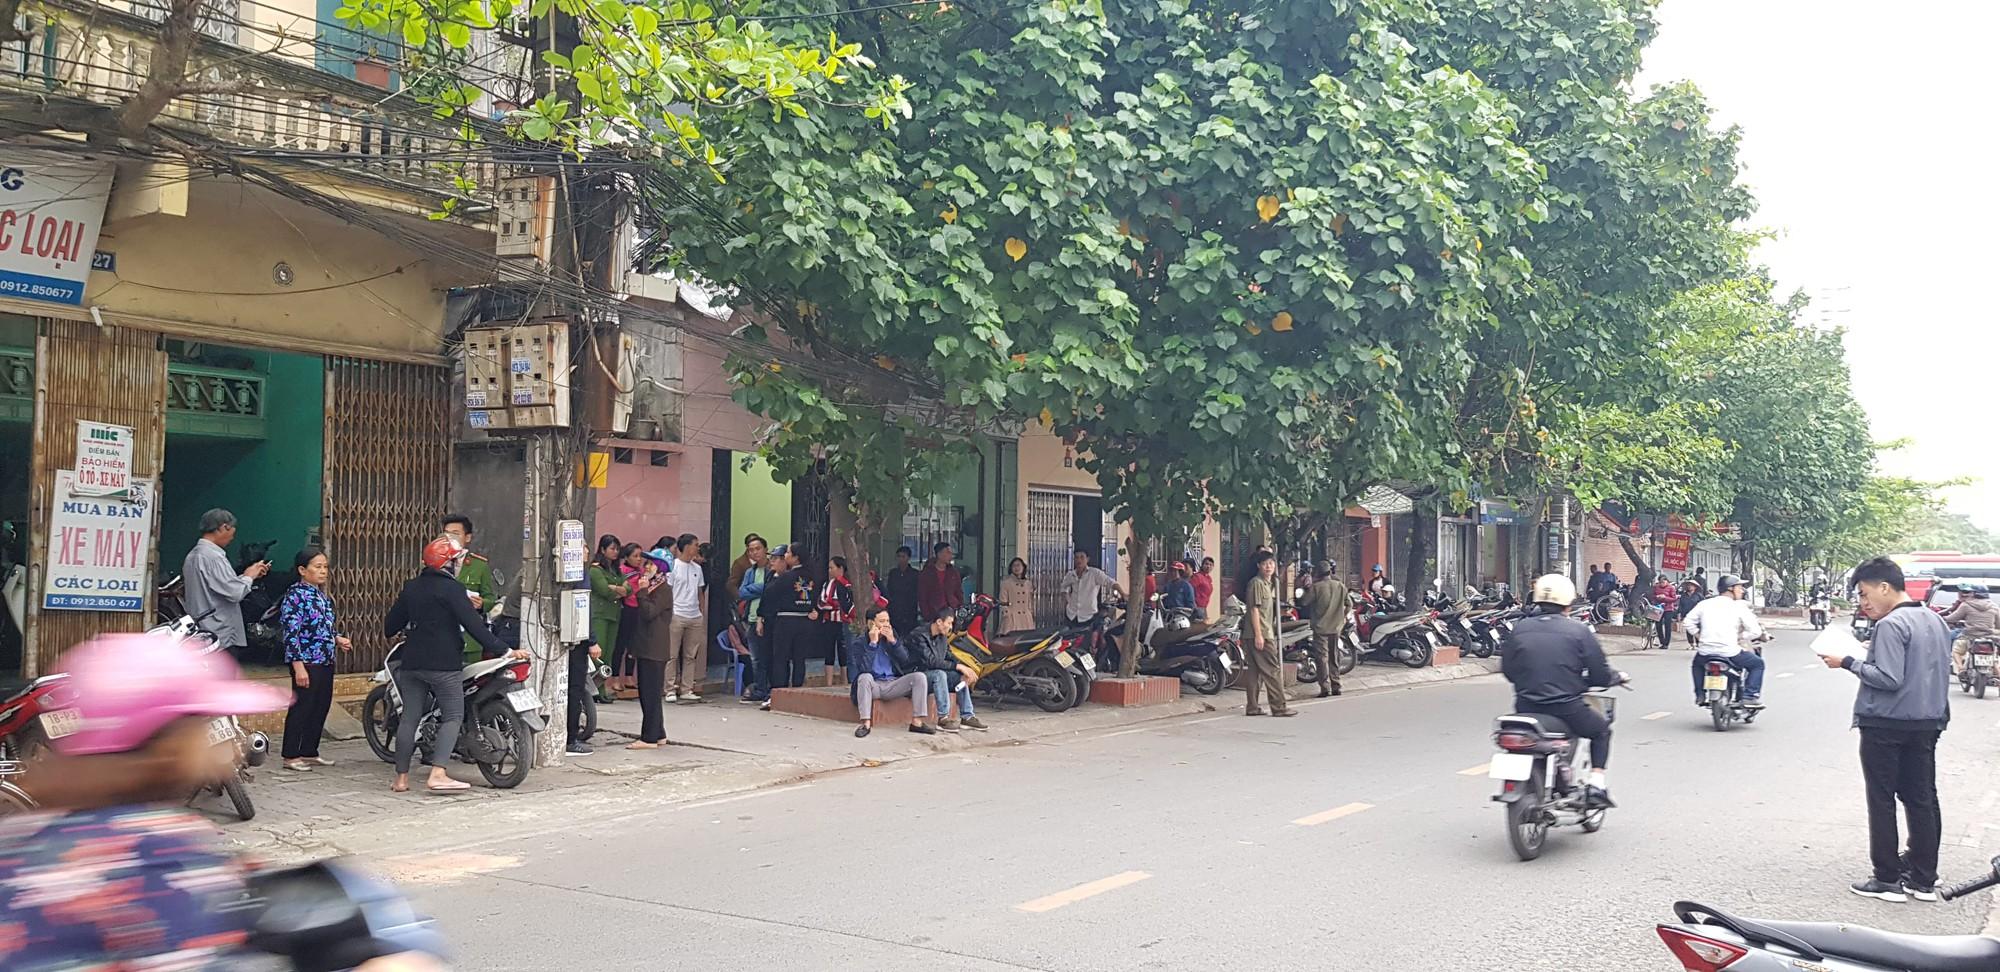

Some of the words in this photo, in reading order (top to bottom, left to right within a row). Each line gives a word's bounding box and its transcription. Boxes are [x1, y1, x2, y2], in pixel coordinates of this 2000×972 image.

[21, 214, 85, 269] LOẠI
[0, 280, 74, 299] 0912.850677
[81, 455, 102, 467] BẢO
[110, 469, 126, 488] MÁY
[62, 501, 103, 517] MUA
[106, 503, 144, 519] BÁN
[58, 526, 88, 566] XE
[93, 523, 142, 569] MÁY
[54, 575, 94, 590] CÁC
[97, 579, 138, 594] LOẠI
[70, 597, 117, 606] 0912.850
[118, 599, 137, 608] 677
